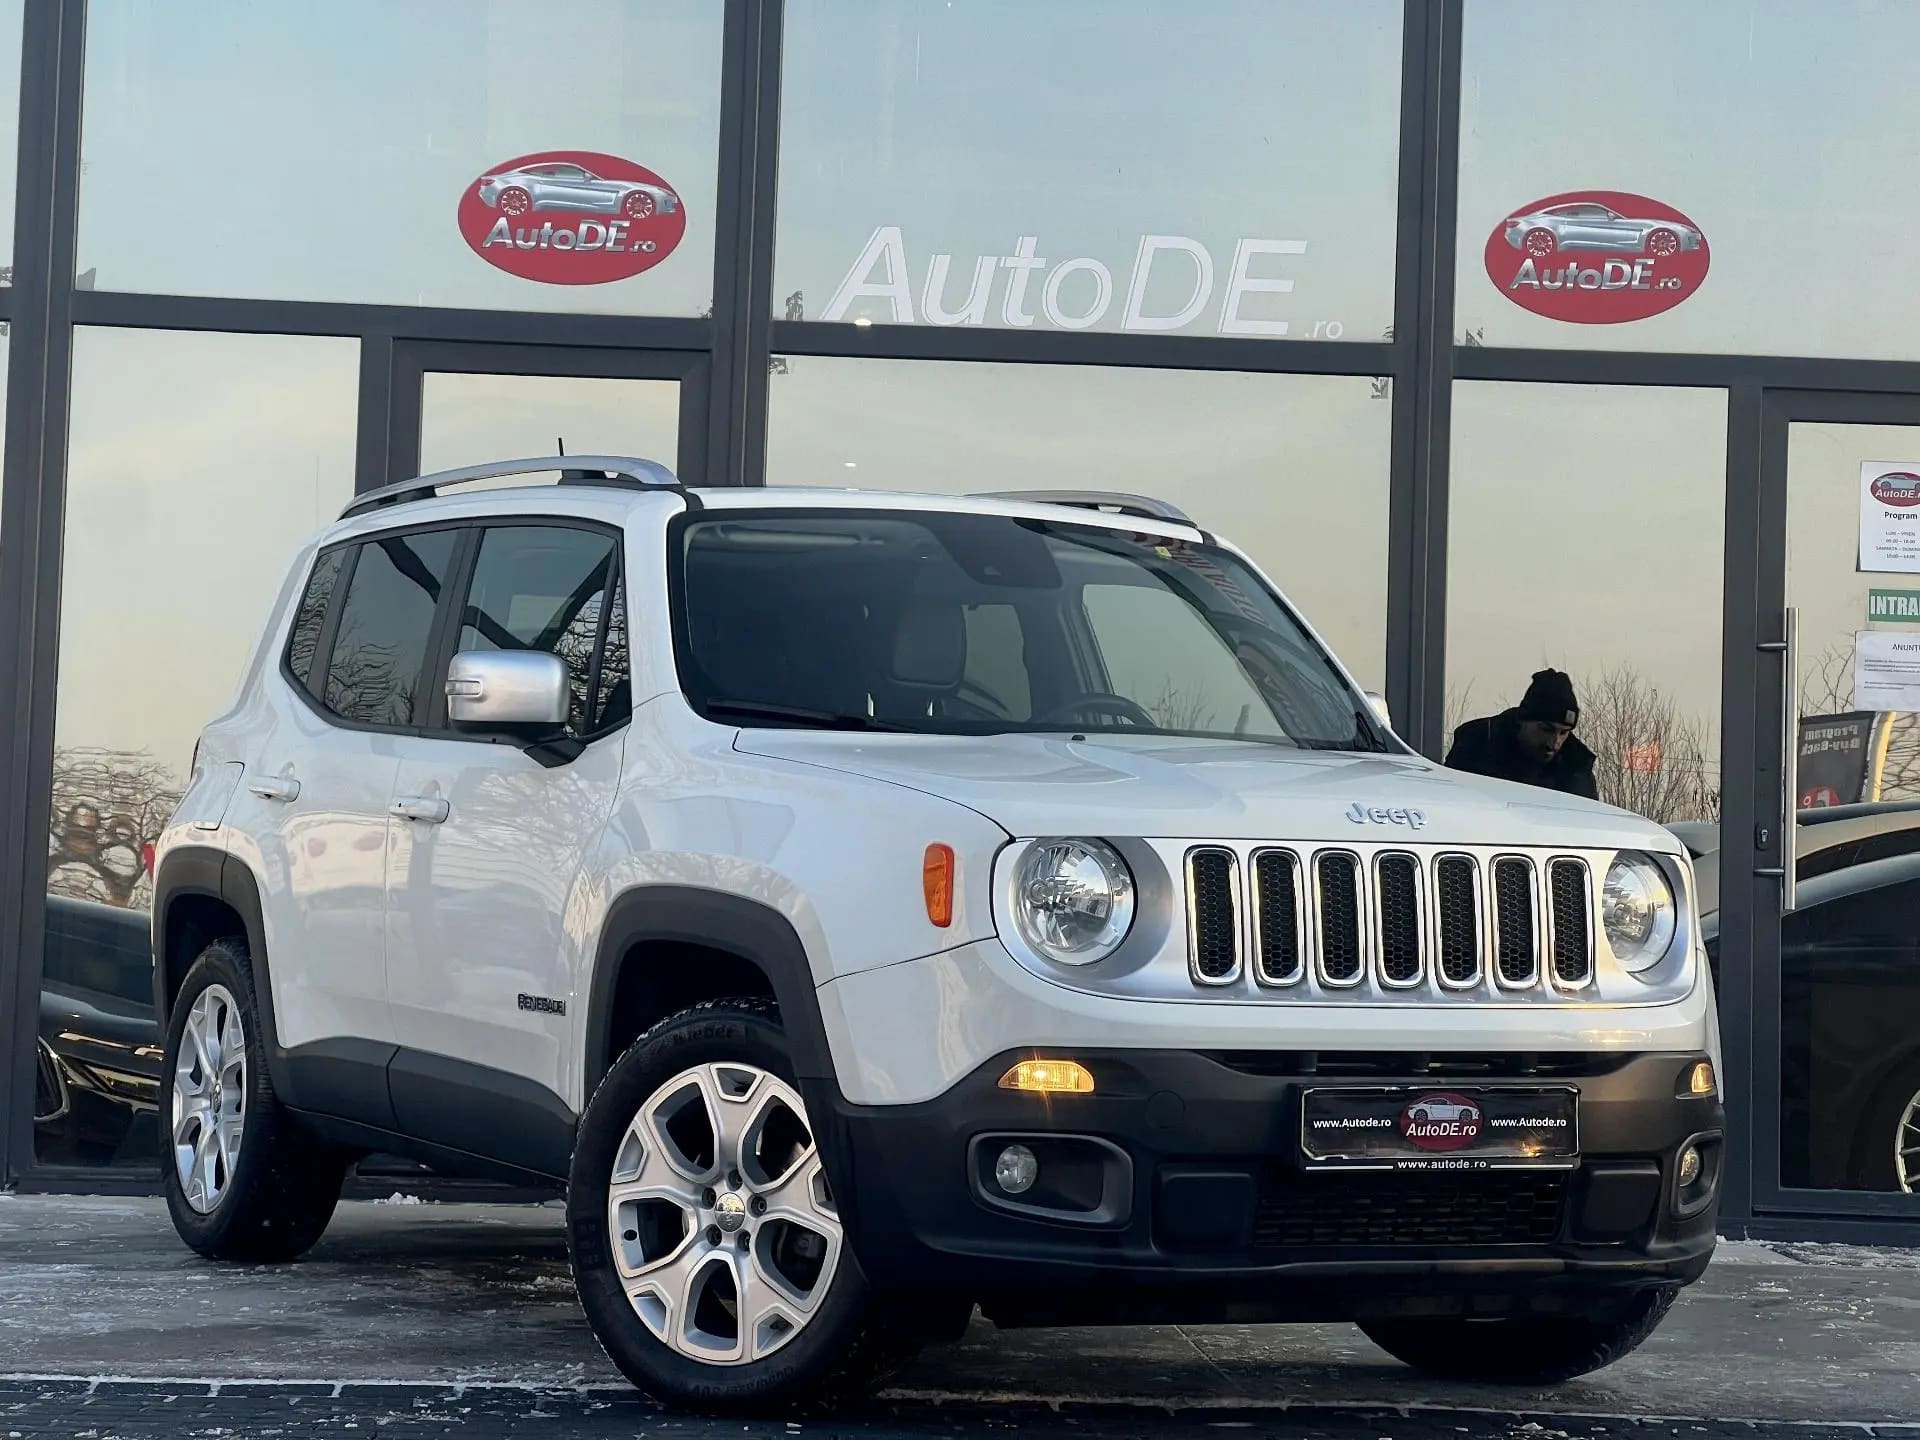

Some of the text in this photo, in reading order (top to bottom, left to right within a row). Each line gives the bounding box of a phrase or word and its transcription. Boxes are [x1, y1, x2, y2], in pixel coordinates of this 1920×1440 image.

[1884, 511, 1918, 521] Program
[1870, 595, 1920, 616] INTRA
[1892, 643, 1920, 653] ANUNT
[1345, 800, 1428, 830] Jeep
[1313, 1116, 1567, 1138] www.Autode.ro AutoDE.ro www.Autode.ro
[1397, 1159, 1487, 1170] www.autode.ro
